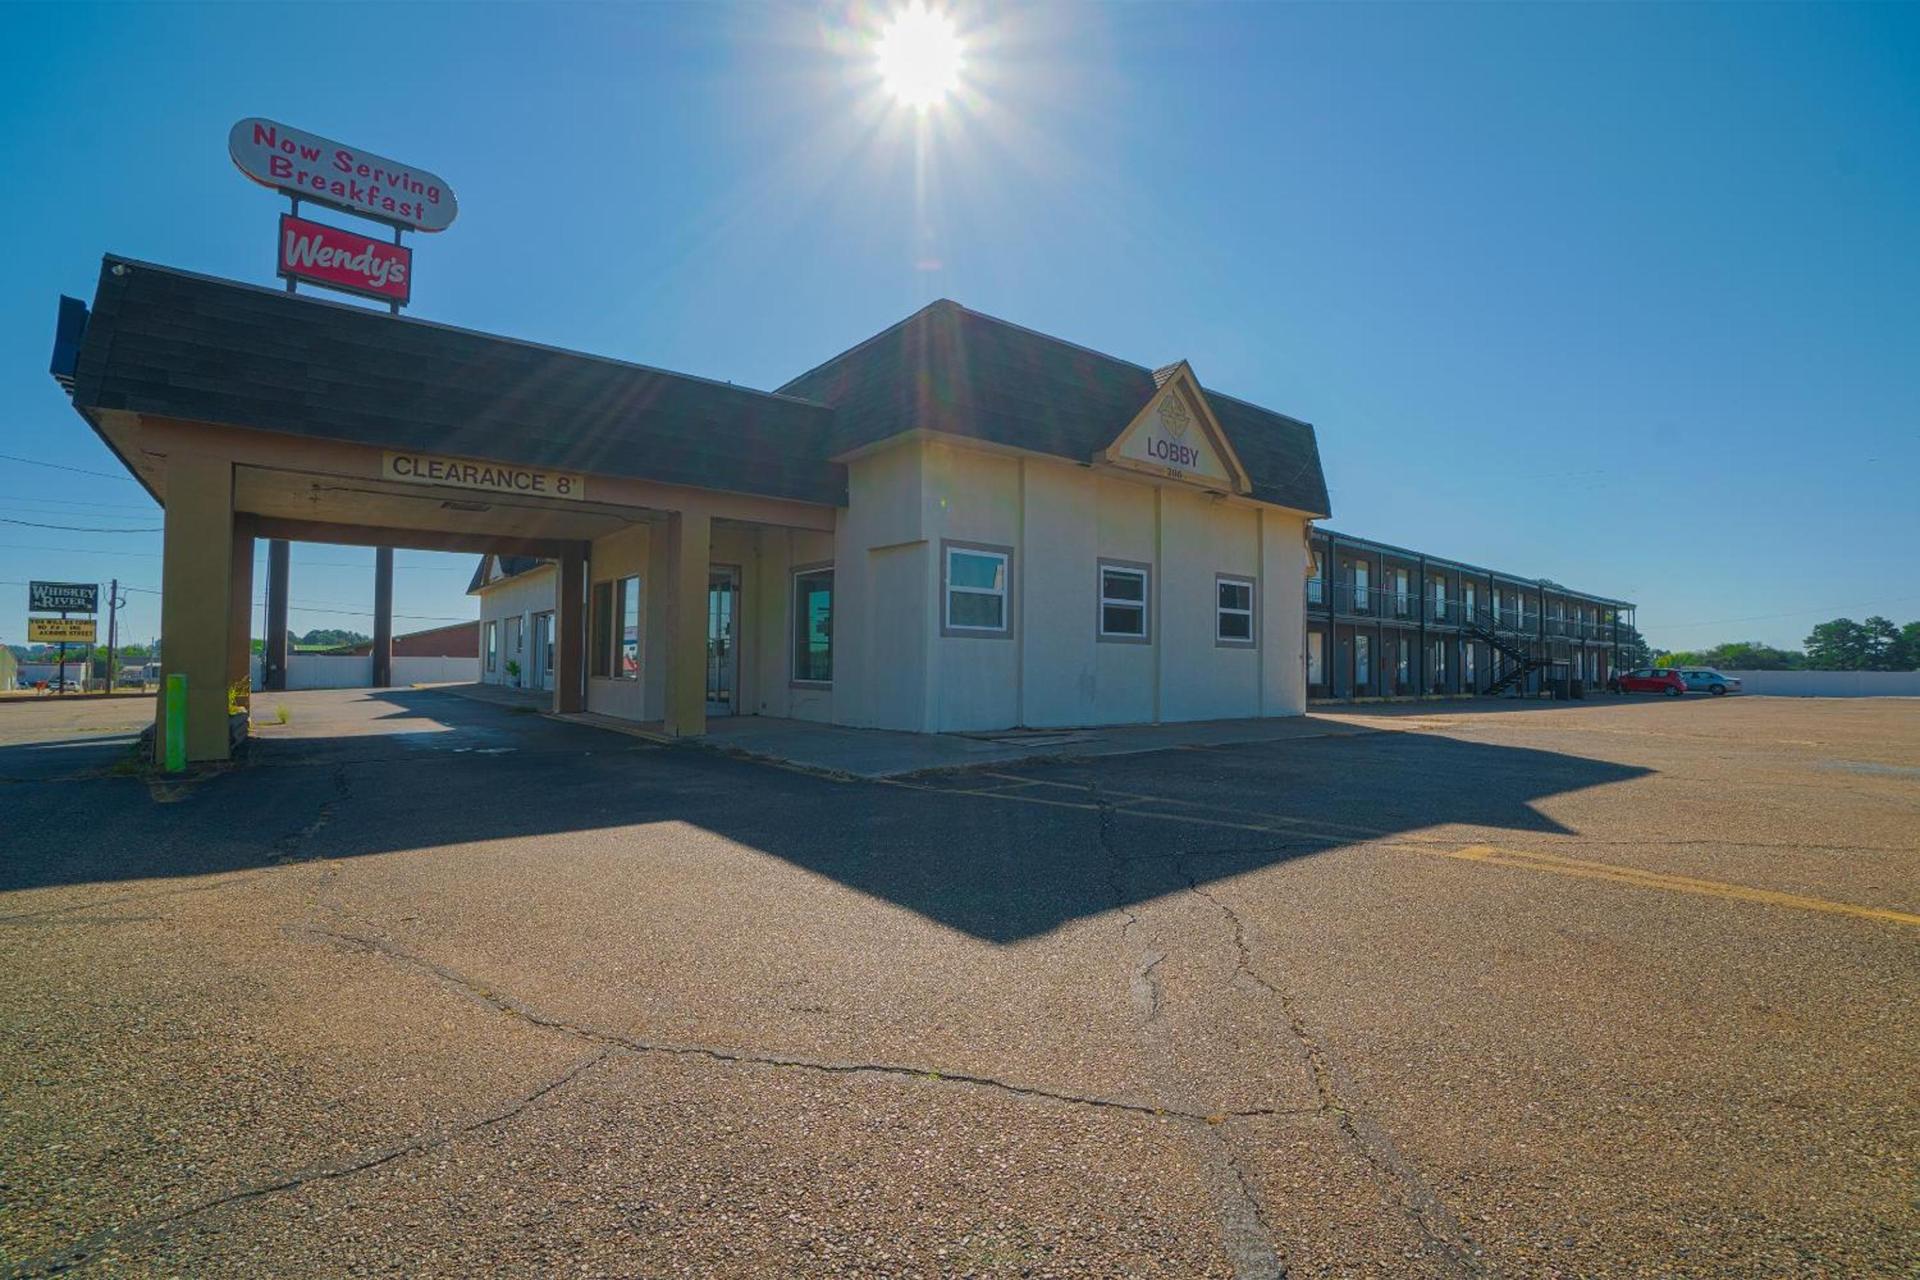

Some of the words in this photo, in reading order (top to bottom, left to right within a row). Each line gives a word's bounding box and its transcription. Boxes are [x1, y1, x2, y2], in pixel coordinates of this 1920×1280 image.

[253, 123, 321, 162] Now
[332, 150, 441, 205] Serving
[270, 154, 424, 220] Breakfast
[285, 230, 406, 288] Wendy's
[392, 456, 545, 492] CLEARANCE
[1147, 437, 1199, 467] LOBBY
